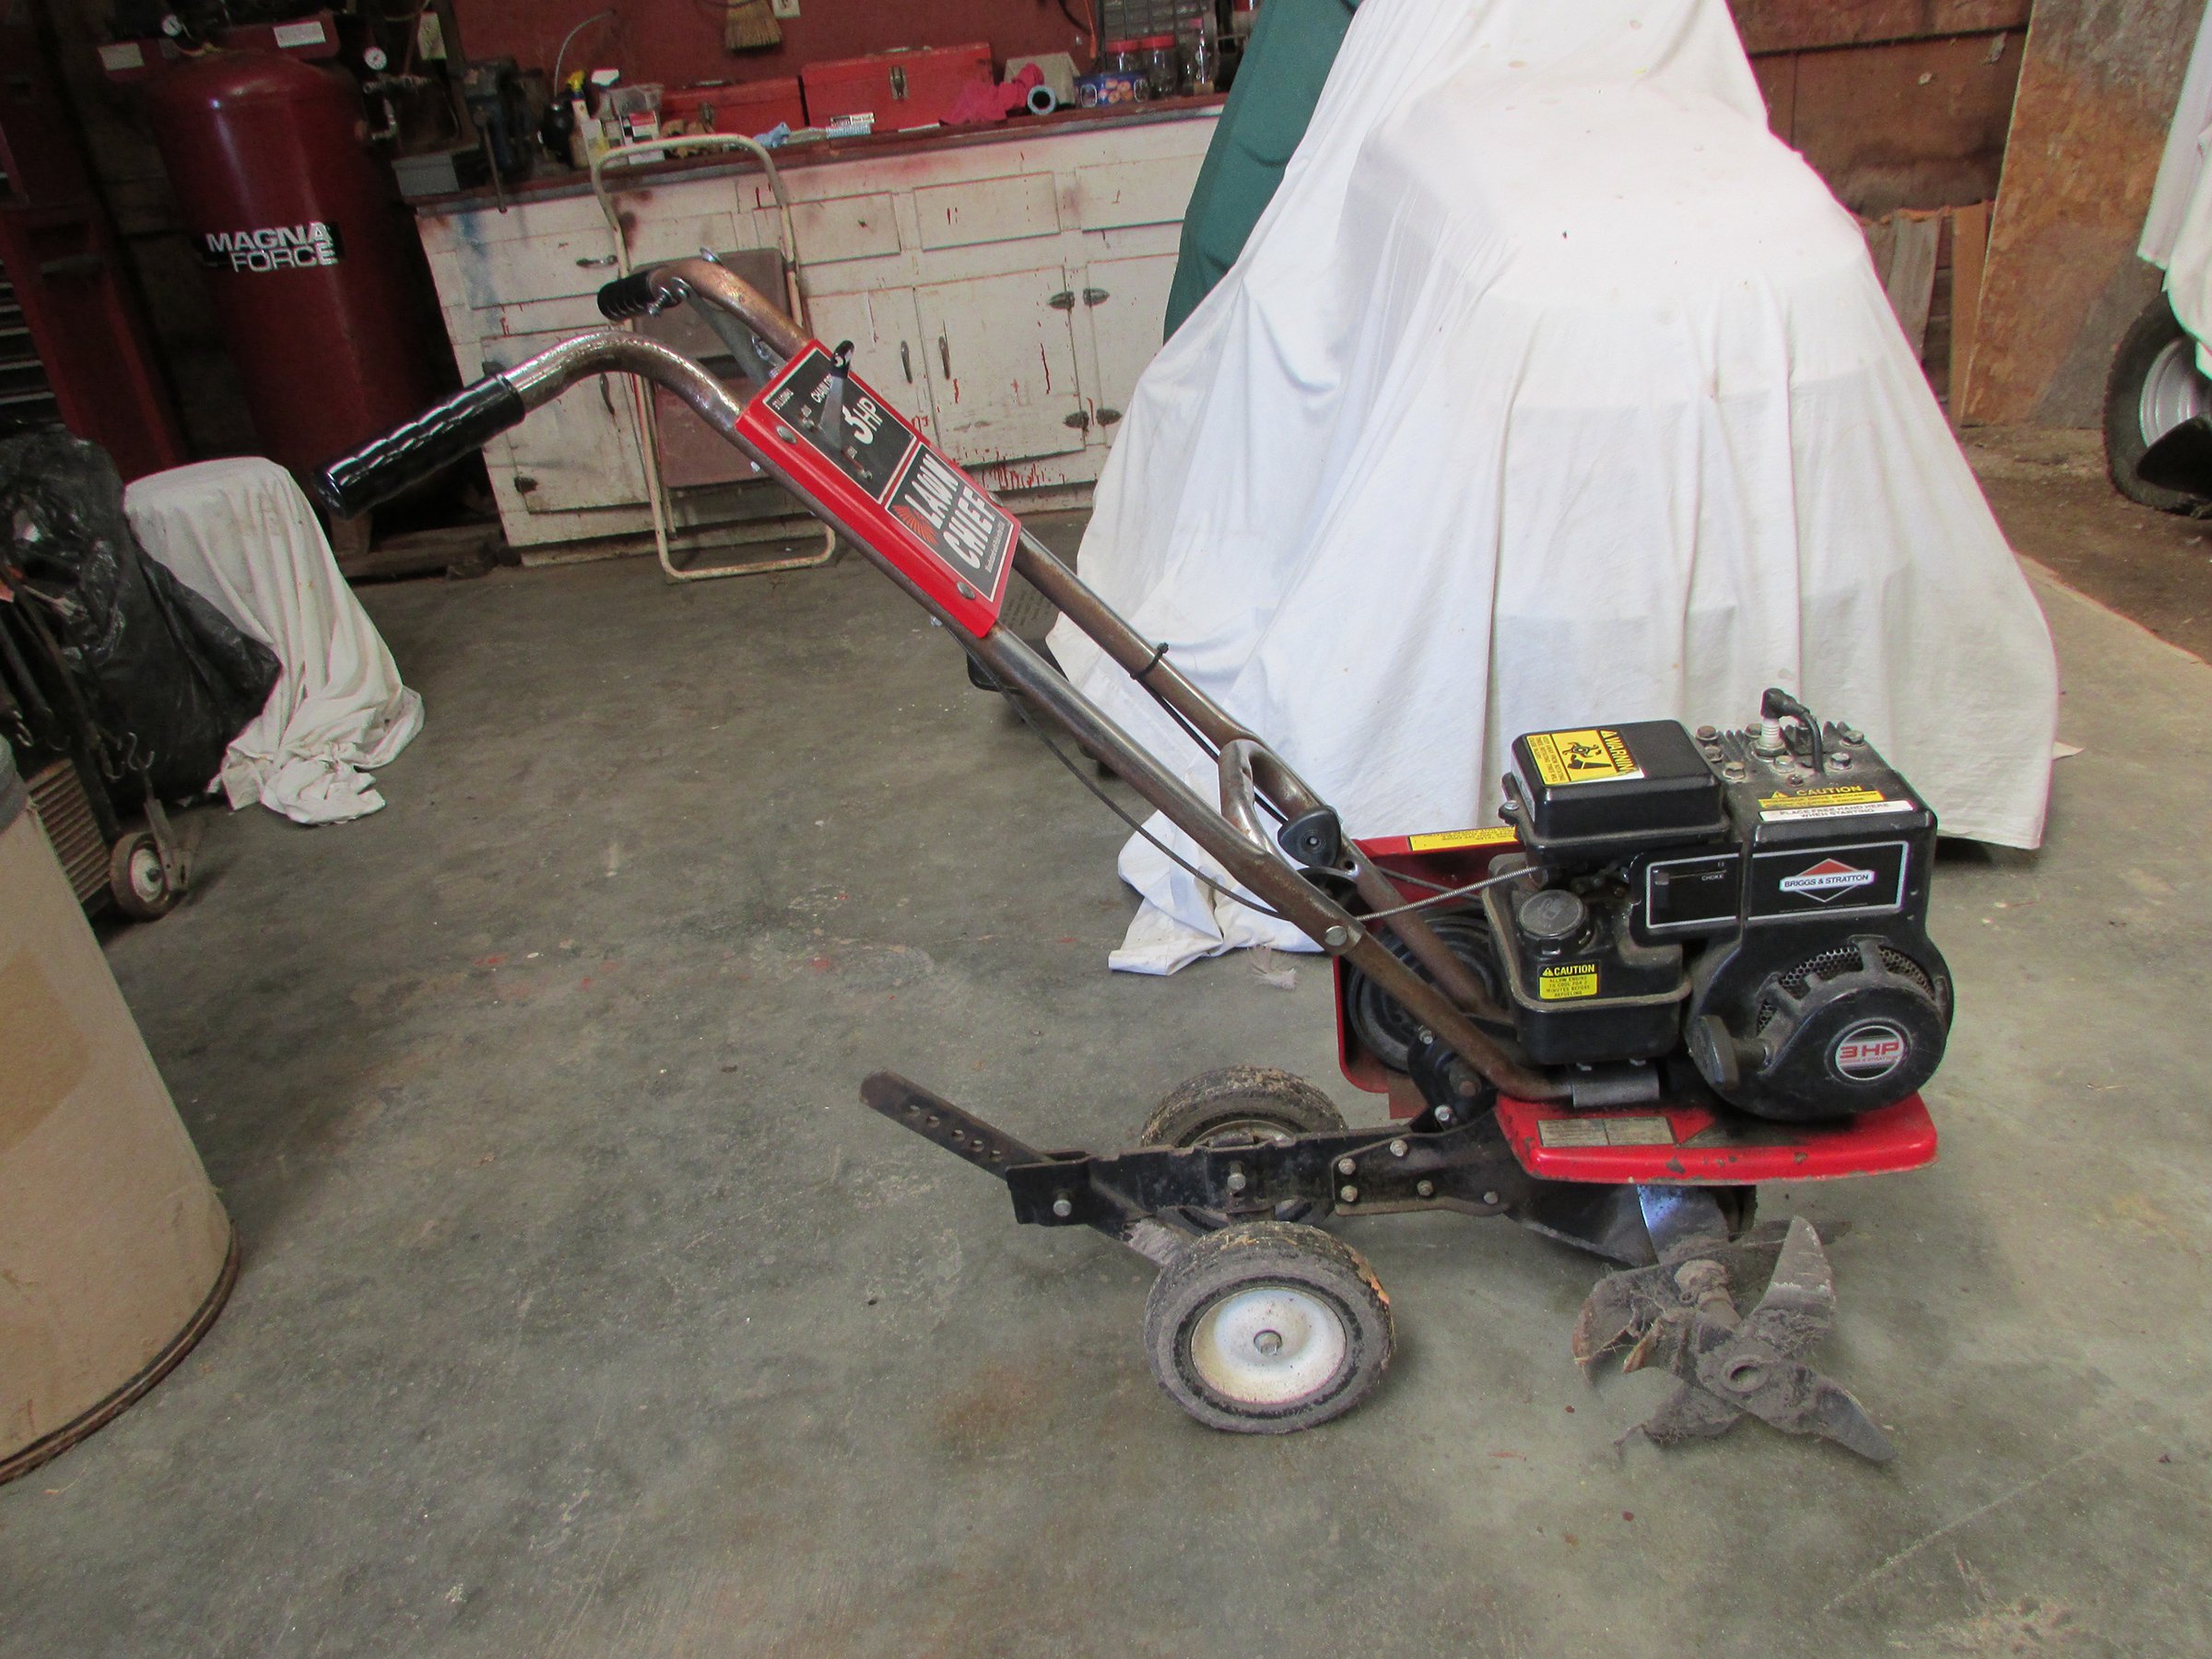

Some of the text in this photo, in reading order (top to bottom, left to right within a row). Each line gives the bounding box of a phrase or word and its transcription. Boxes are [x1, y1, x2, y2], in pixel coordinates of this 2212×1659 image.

[206, 221, 333, 253] MAGNA
[231, 241, 339, 273] FORCE
[841, 396, 883, 444] 3HP
[904, 453, 959, 530] LAWN
[943, 486, 995, 569] CHIEF
[1605, 736, 1637, 774] WARNIN
[1796, 785, 1862, 796] CAUTION
[1784, 878, 1817, 888] BRIGGS
[1825, 874, 1868, 884] STRATTON
[1554, 964, 1594, 976] CAUTION
